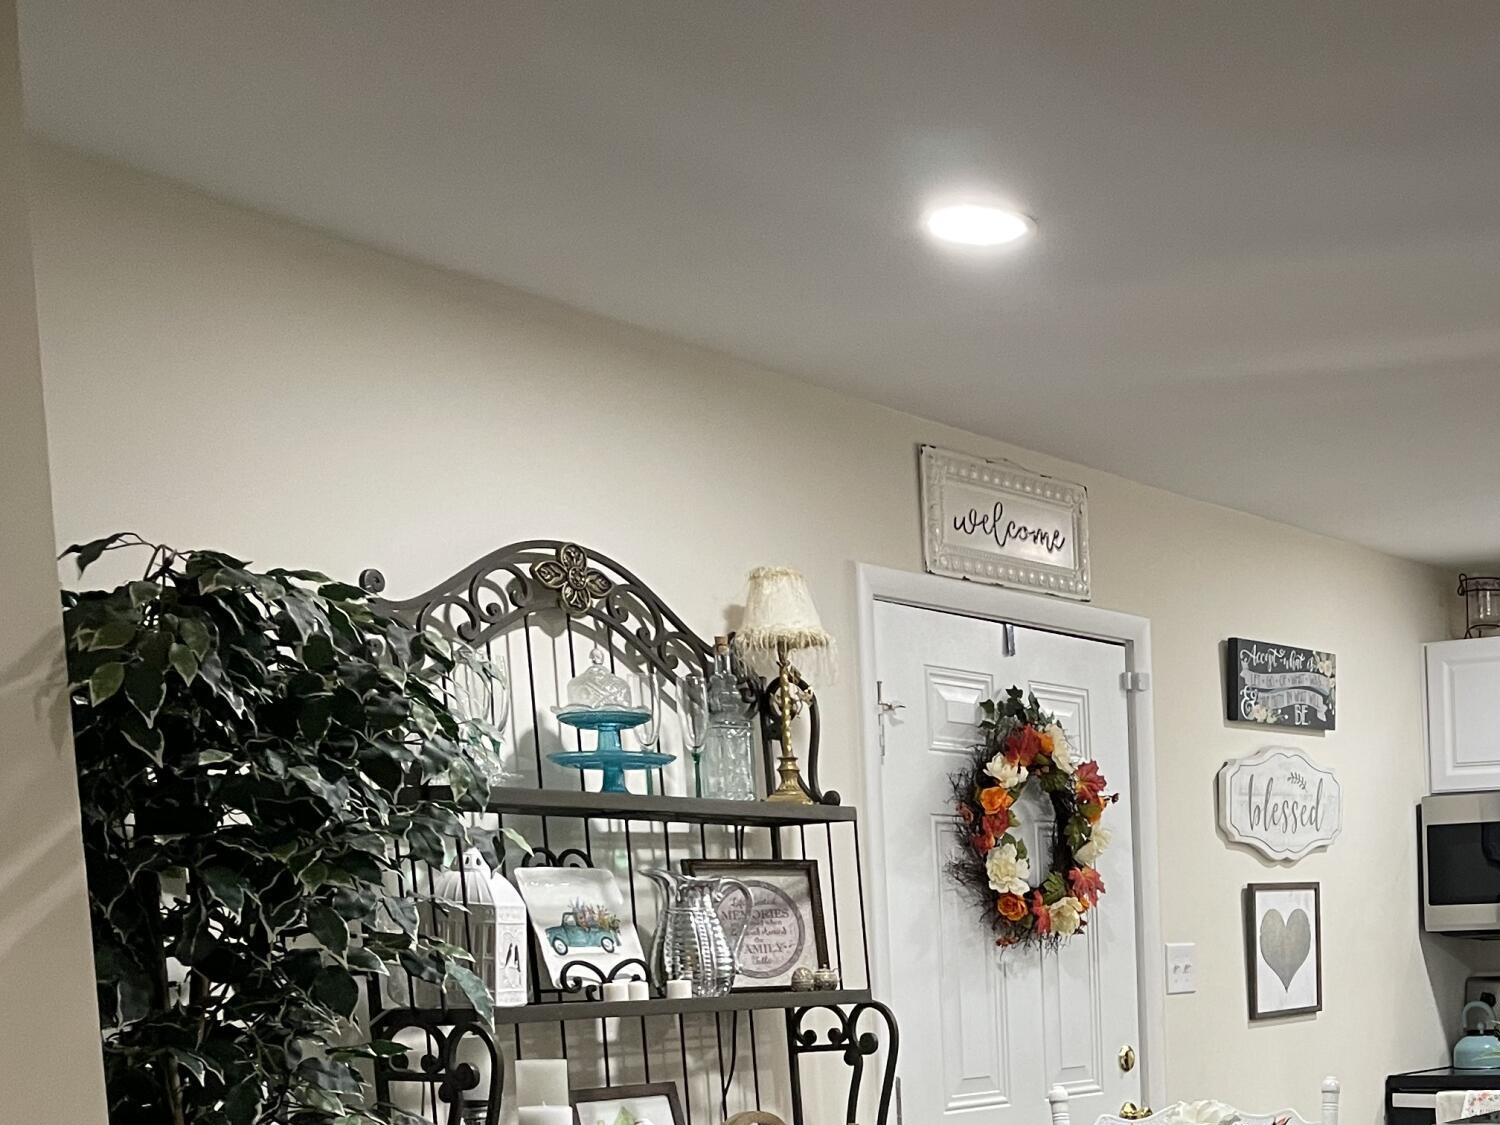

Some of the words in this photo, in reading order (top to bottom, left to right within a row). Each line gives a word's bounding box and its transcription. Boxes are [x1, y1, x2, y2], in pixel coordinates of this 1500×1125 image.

[953, 501, 1066, 554] welcome
[1248, 773, 1323, 834] blessed
[743, 943, 784, 955] AMILY
